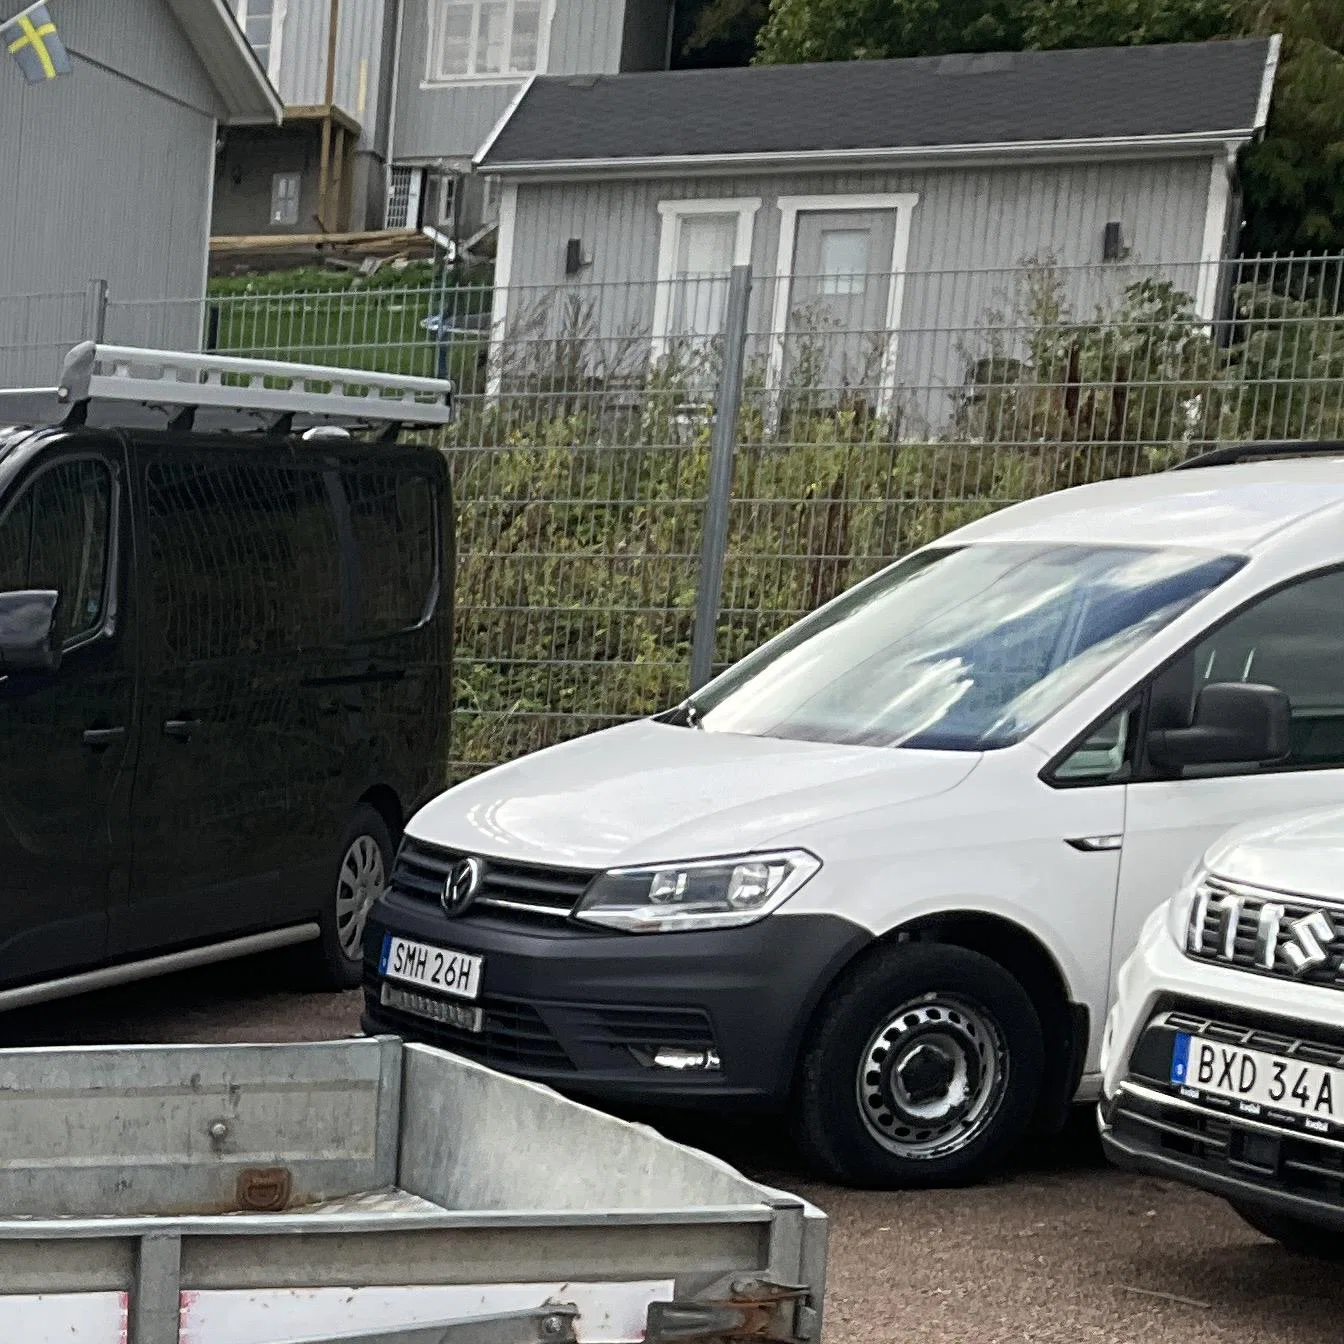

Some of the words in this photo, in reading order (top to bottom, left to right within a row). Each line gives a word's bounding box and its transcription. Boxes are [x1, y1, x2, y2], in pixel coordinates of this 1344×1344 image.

[394, 942, 428, 979] SMH
[431, 952, 471, 990] 26H
[1198, 1044, 1256, 1093] BXD
[1269, 1061, 1333, 1114] 34A
